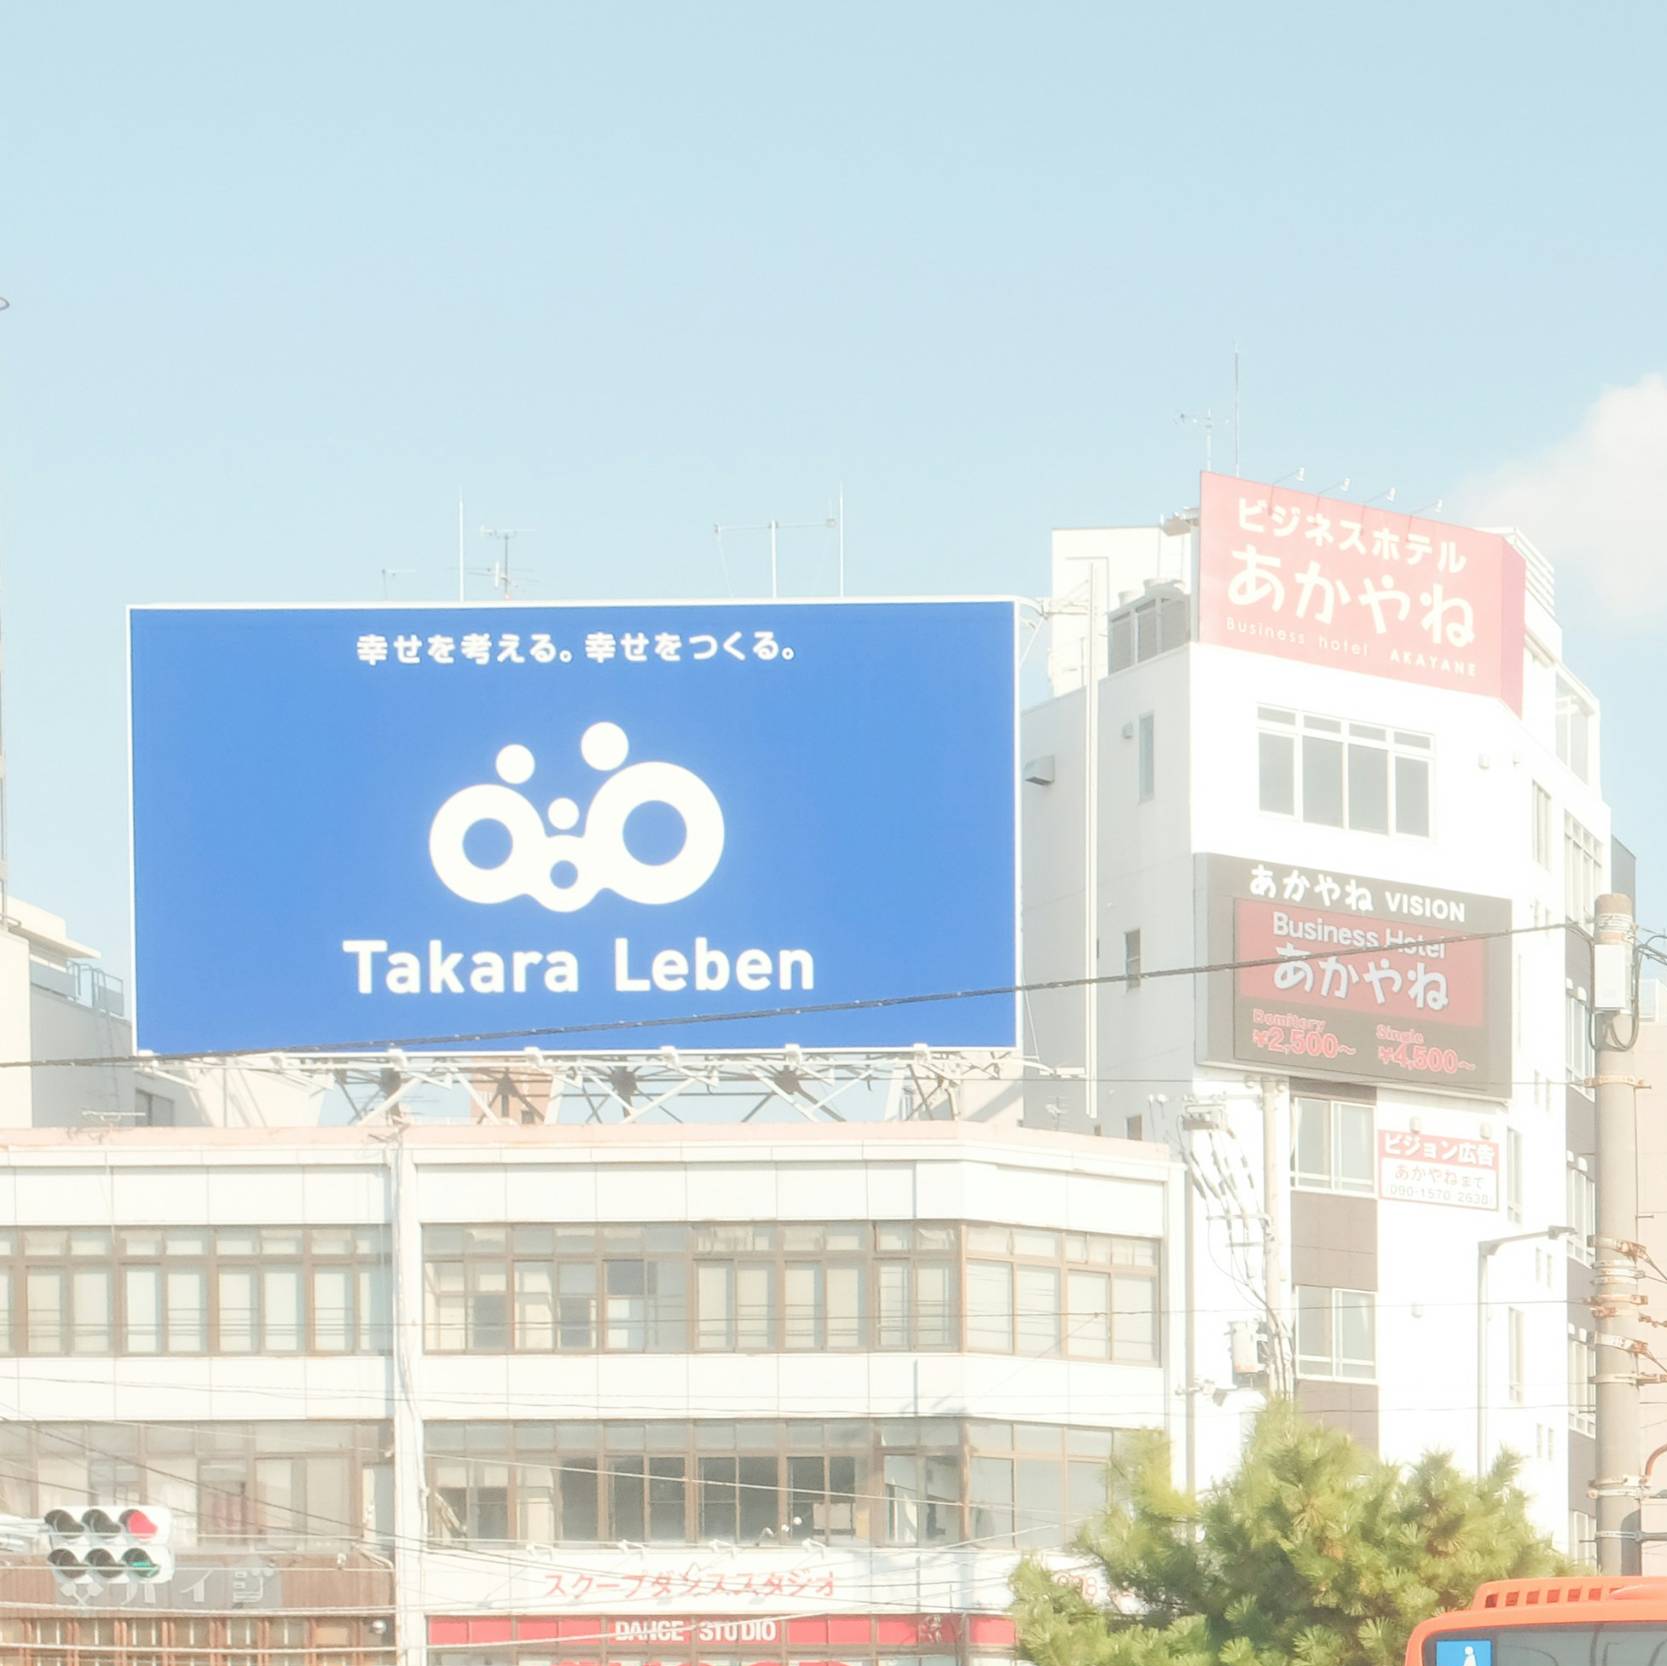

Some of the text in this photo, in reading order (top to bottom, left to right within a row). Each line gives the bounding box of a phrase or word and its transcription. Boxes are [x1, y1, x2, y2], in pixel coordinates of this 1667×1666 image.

[1238, 497, 1467, 575] ビジネスホテル
[1227, 544, 1476, 647] あかやね
[356, 631, 796, 665] 幸せを考える。幸せをつくる。
[1226, 616, 1477, 678] Business hotel AKAYANE
[1250, 864, 1465, 922] あかやね VISION
[1272, 911, 1446, 959] Business Hotel
[343, 938, 815, 996] Takara Leben
[1274, 943, 1449, 1011] あかやね
[1384, 1132, 1495, 1167] ビジョン広告
[615, 1620, 777, 1641] DANCE STUDIO
